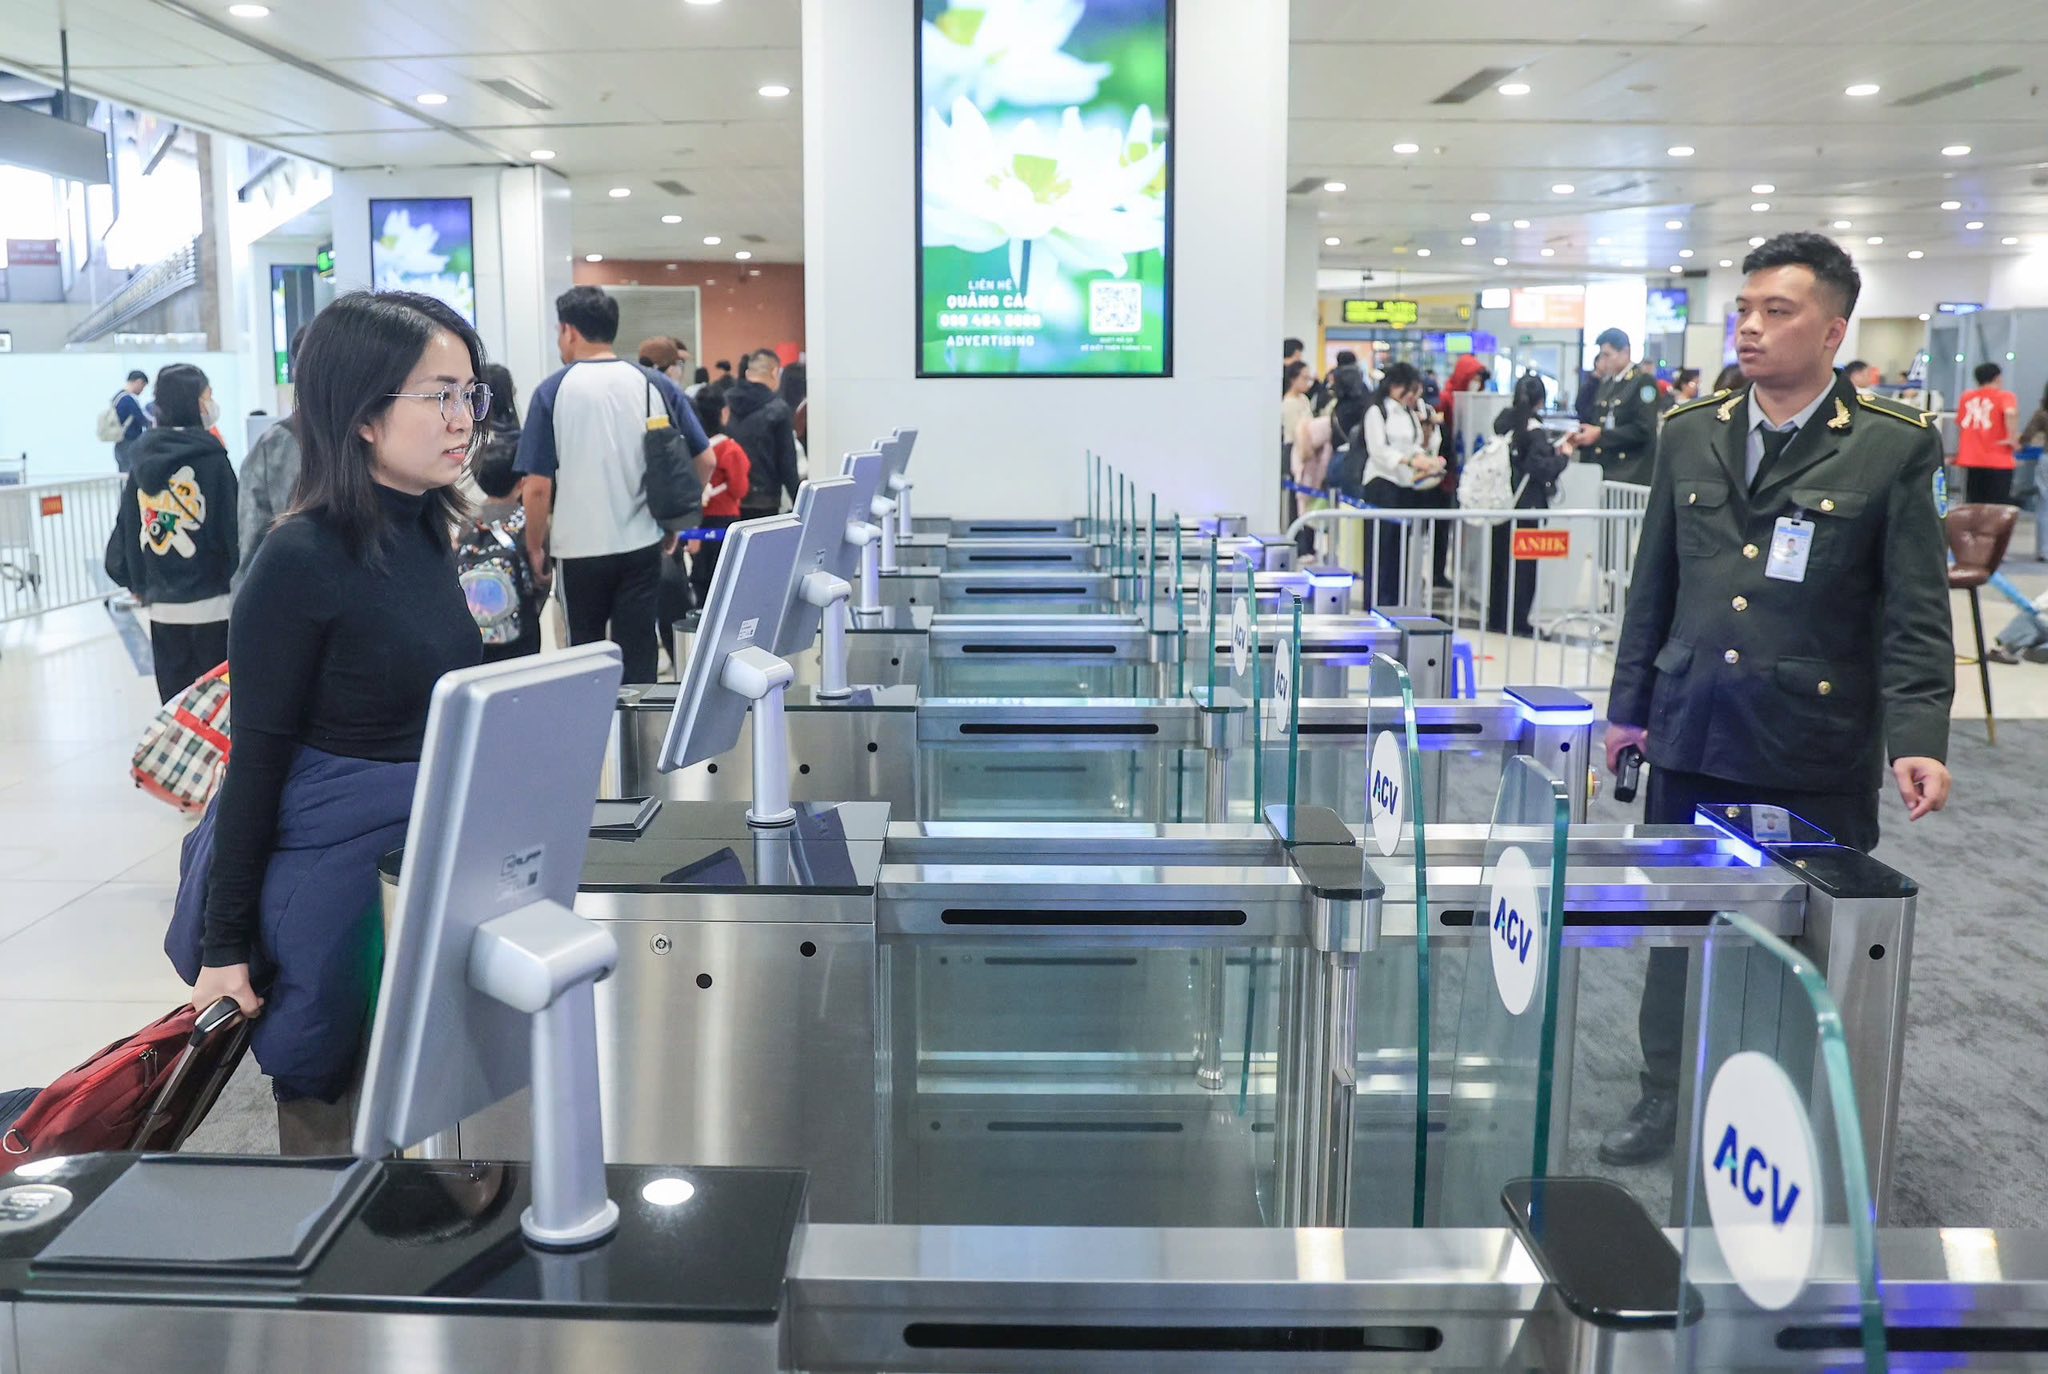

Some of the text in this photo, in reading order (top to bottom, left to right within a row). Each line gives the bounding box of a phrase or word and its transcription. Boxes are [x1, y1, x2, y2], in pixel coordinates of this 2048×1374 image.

[946, 334, 1035, 348] ADVERTISING
[1961, 396, 1994, 430] NY
[1275, 669, 1288, 701] ACV
[1372, 769, 1399, 815] ACV
[1494, 896, 1533, 965] ACV
[1712, 1124, 1800, 1225] ACV
